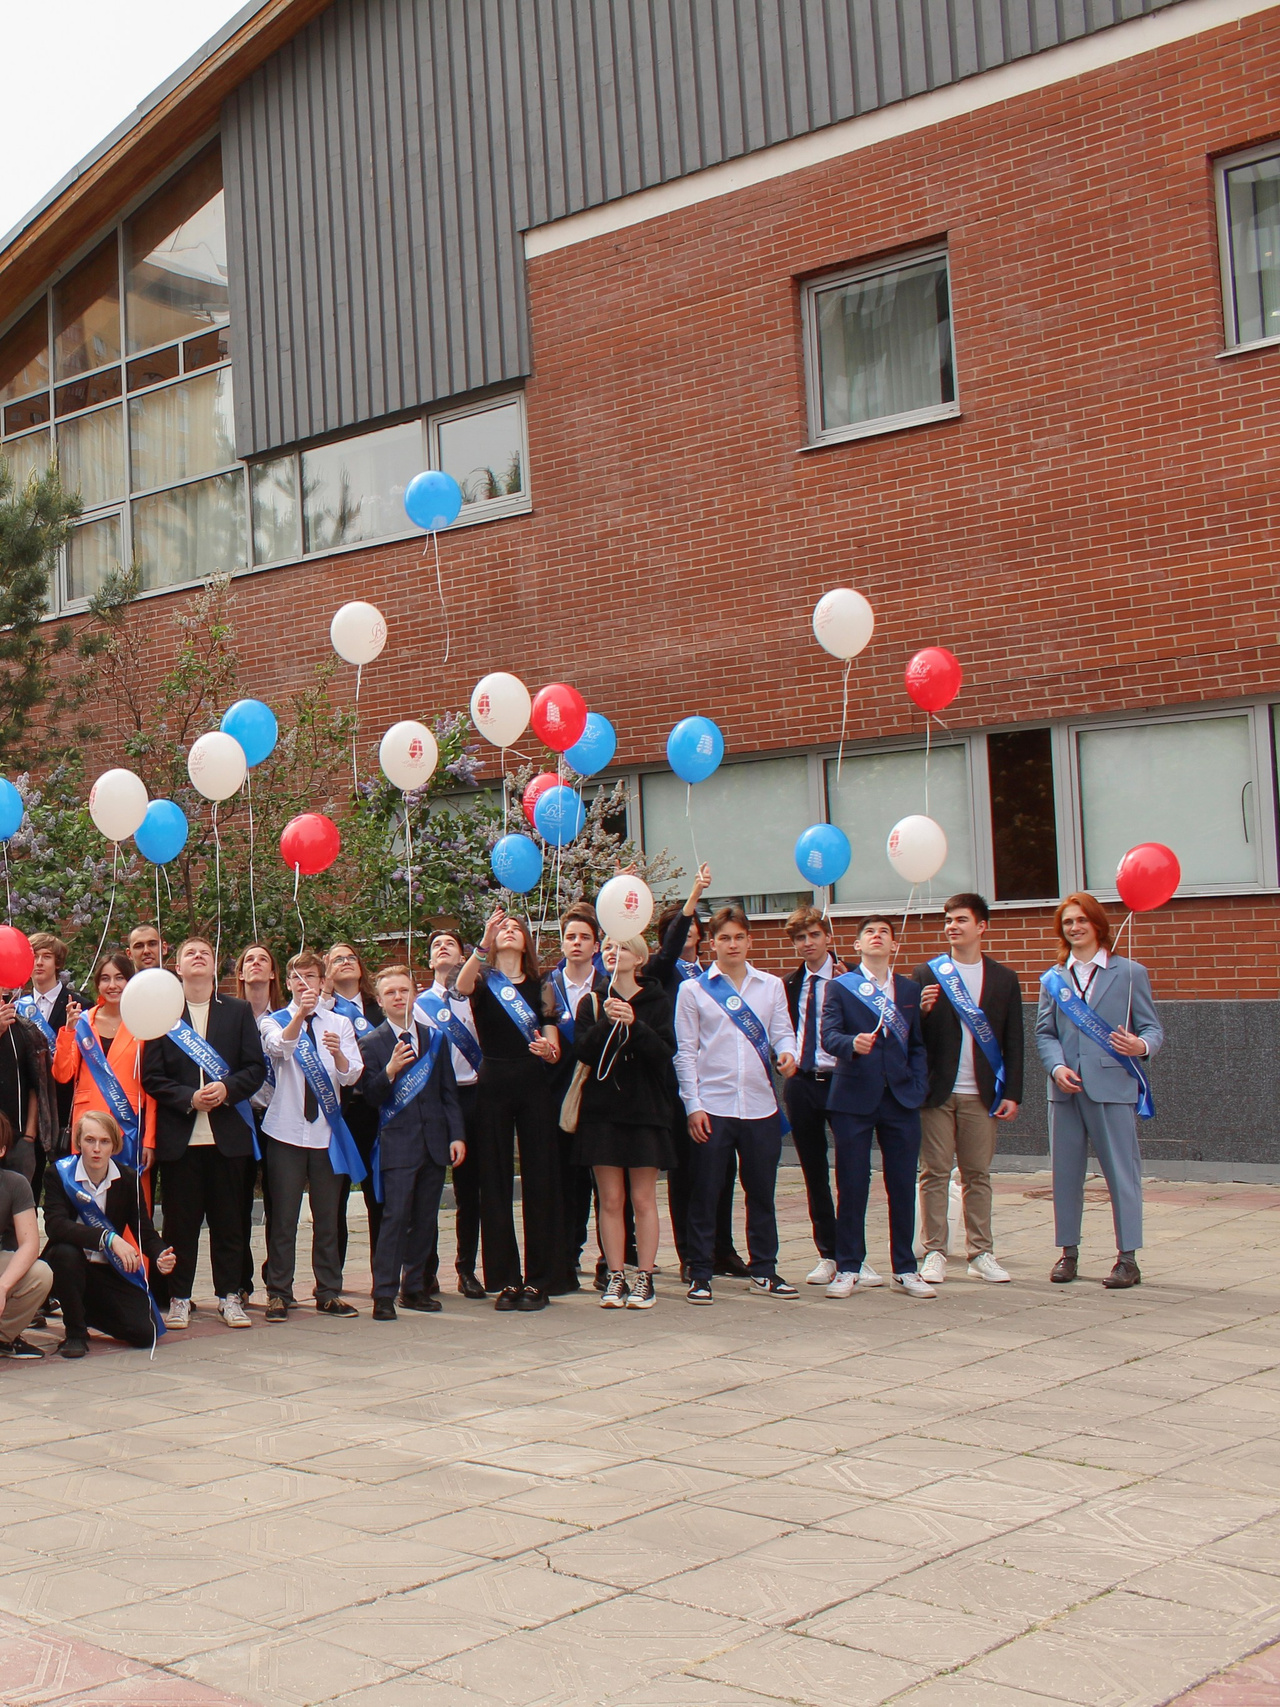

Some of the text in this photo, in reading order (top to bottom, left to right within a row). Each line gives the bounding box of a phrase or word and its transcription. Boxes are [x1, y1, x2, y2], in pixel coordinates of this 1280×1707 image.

[872, 996, 909, 1037] Выпускни
[975, 1022, 993, 1042] 2023
[178, 1029, 222, 1074] Выпускник
[297, 1040, 327, 1093] Выпускник
[322, 1092, 337, 1113] 2023
